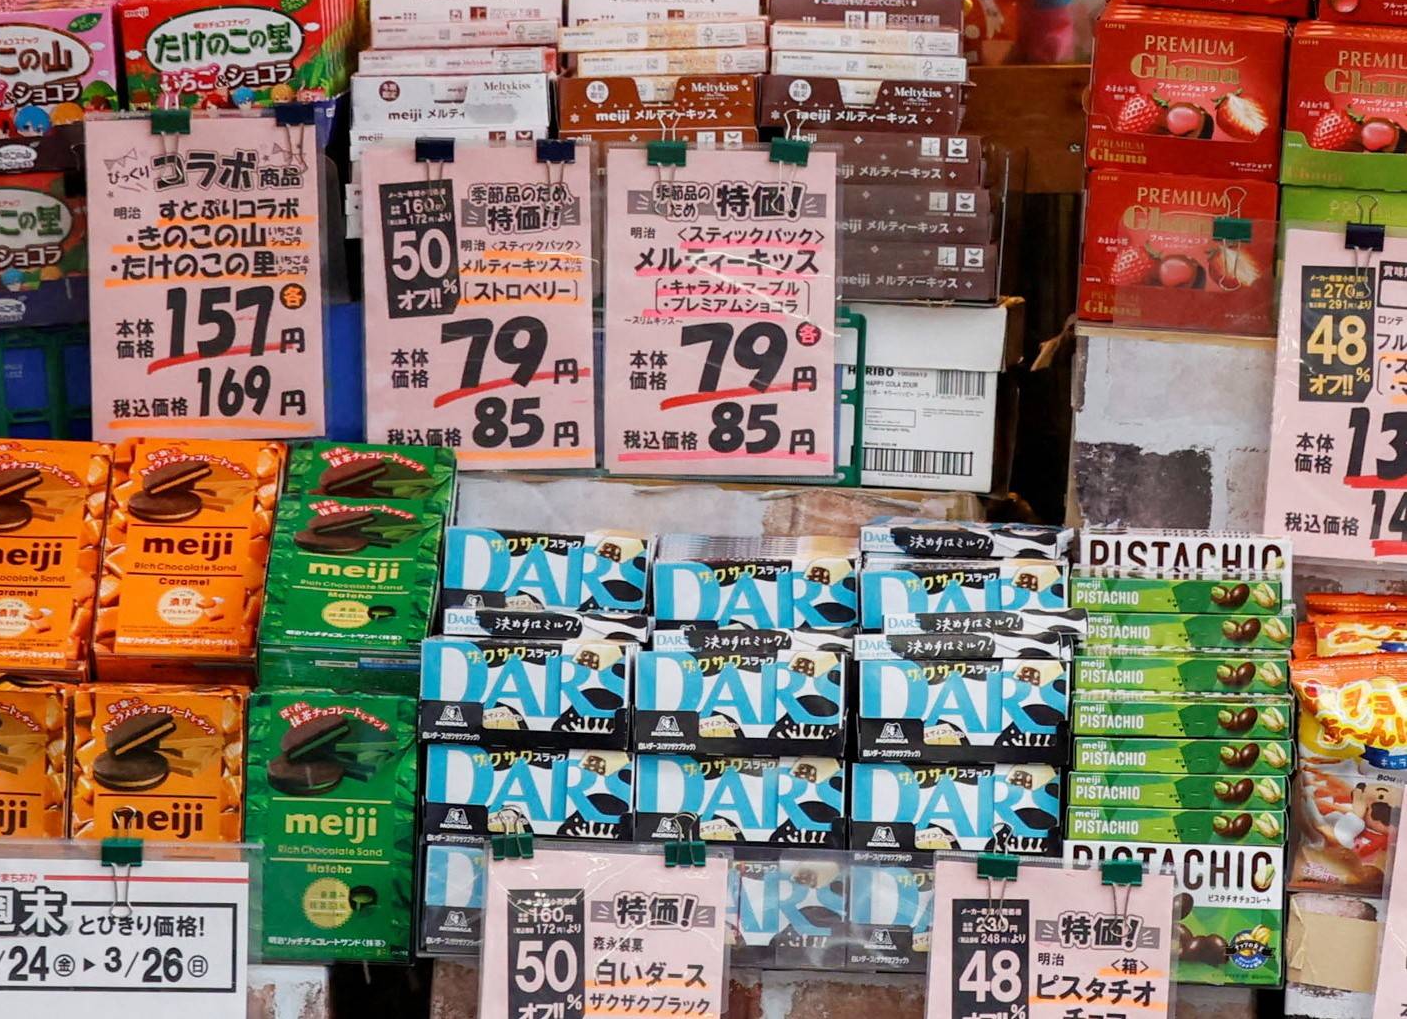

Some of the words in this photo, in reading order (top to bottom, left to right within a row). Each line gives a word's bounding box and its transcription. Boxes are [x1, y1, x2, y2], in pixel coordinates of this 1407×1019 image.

[154, 21, 293, 65] たけのこの里
[1143, 34, 1235, 57] PREMIUM
[1130, 53, 1241, 85] Ghana
[691, 81, 740, 94] Meltykiss
[893, 86, 943, 99] Meltykiss
[387, 108, 423, 122] meiji
[595, 108, 631, 123] meiji
[834, 111, 919, 125] メルティーキッス
[113, 207, 142, 220] 明治
[159, 198, 300, 221] すとぷりコラボ
[630, 227, 656, 239] 明治
[460, 239, 486, 252] 明治
[460, 257, 563, 274] メルティーキッス
[634, 247, 819, 275] メルティーキッス
[116, 318, 155, 338] 本体
[1377, 315, 1404, 326] ロッテ
[116, 340, 155, 359] 価格
[391, 349, 429, 368] 本体
[630, 351, 668, 368] 本体
[391, 370, 430, 389] 価格
[629, 371, 668, 391] 価格
[848, 366, 894, 377] HRIBO
[112, 398, 189, 419] 税込価格
[387, 428, 462, 448] 税込価格
[623, 431, 698, 451] 税込価格
[1296, 433, 1335, 452] 本体
[1294, 454, 1334, 474] 価格
[1284, 512, 1360, 536] 税込価格
[142, 532, 233, 564] meiji
[308, 559, 400, 584] meiji
[443, 527, 649, 611] DARS
[1076, 590, 1139, 606] PISTACHIO
[421, 639, 627, 722] DARS
[859, 659, 1069, 734] DARS
[1081, 751, 1146, 767] PISTACHIO
[425, 743, 634, 825] DARS
[1075, 785, 1141, 801] PISTACHIO
[851, 762, 1060, 839] DARS
[284, 807, 378, 839] meiji
[1074, 820, 1139, 835] PISTACHIO
[305, 863, 353, 875] Matcha
[78, 915, 206, 939] とびきり価格!
[1037, 953, 1065, 966] 明治
[594, 962, 707, 989] 白いダース
[1036, 974, 1156, 1006] ピスタチオ
[589, 993, 710, 1017] ザクザクブラック
